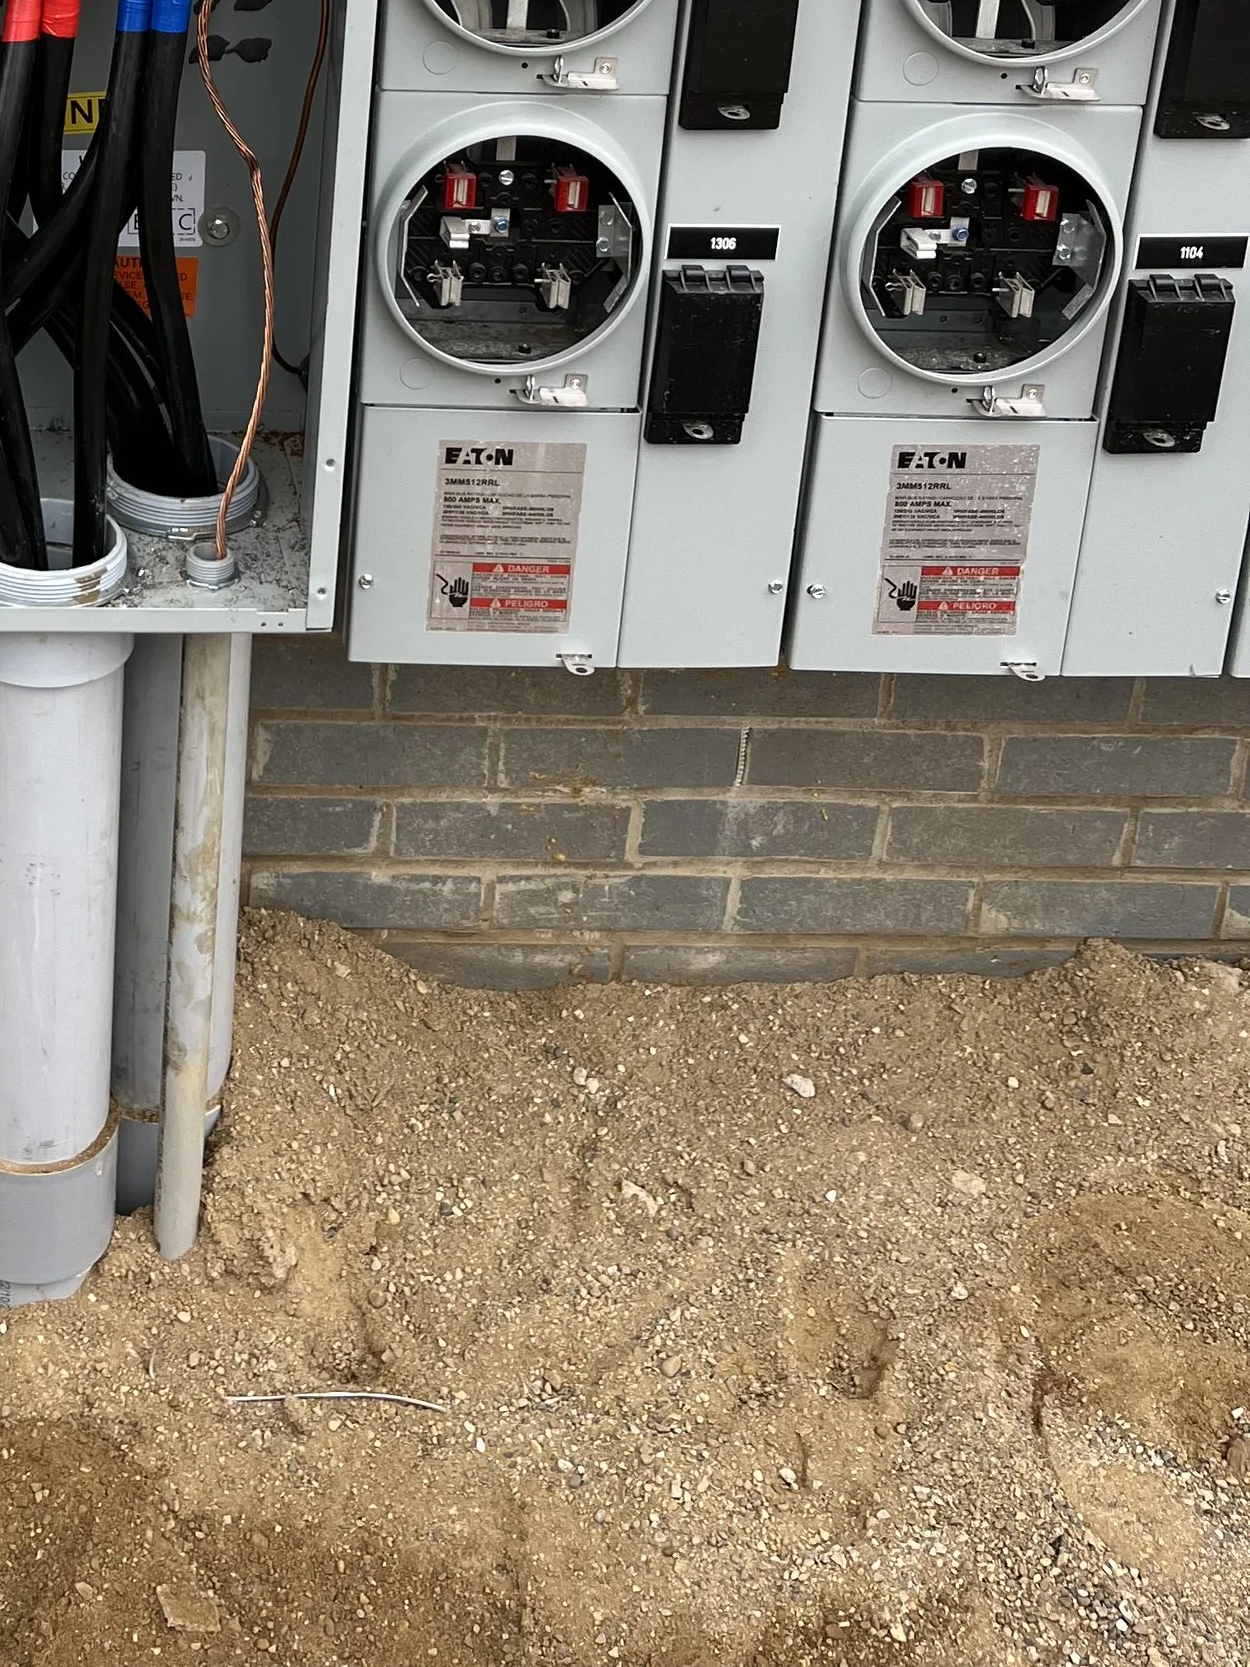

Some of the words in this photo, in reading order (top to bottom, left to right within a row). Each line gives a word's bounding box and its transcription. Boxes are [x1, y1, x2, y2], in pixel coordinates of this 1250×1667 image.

[710, 236, 737, 250] 1306
[1180, 246, 1204, 259] 1104
[444, 447, 514, 466] EATON
[897, 451, 967, 469] EATON
[444, 477, 500, 487] 3MM512RRL
[896, 482, 952, 490] 3MM512RRL
[458, 496, 480, 504] AMPS
[507, 565, 550, 574] DANGER
[956, 567, 999, 576] DANGER
[505, 600, 549, 608] PELIGRO
[953, 602, 997, 610] PELIGRO
